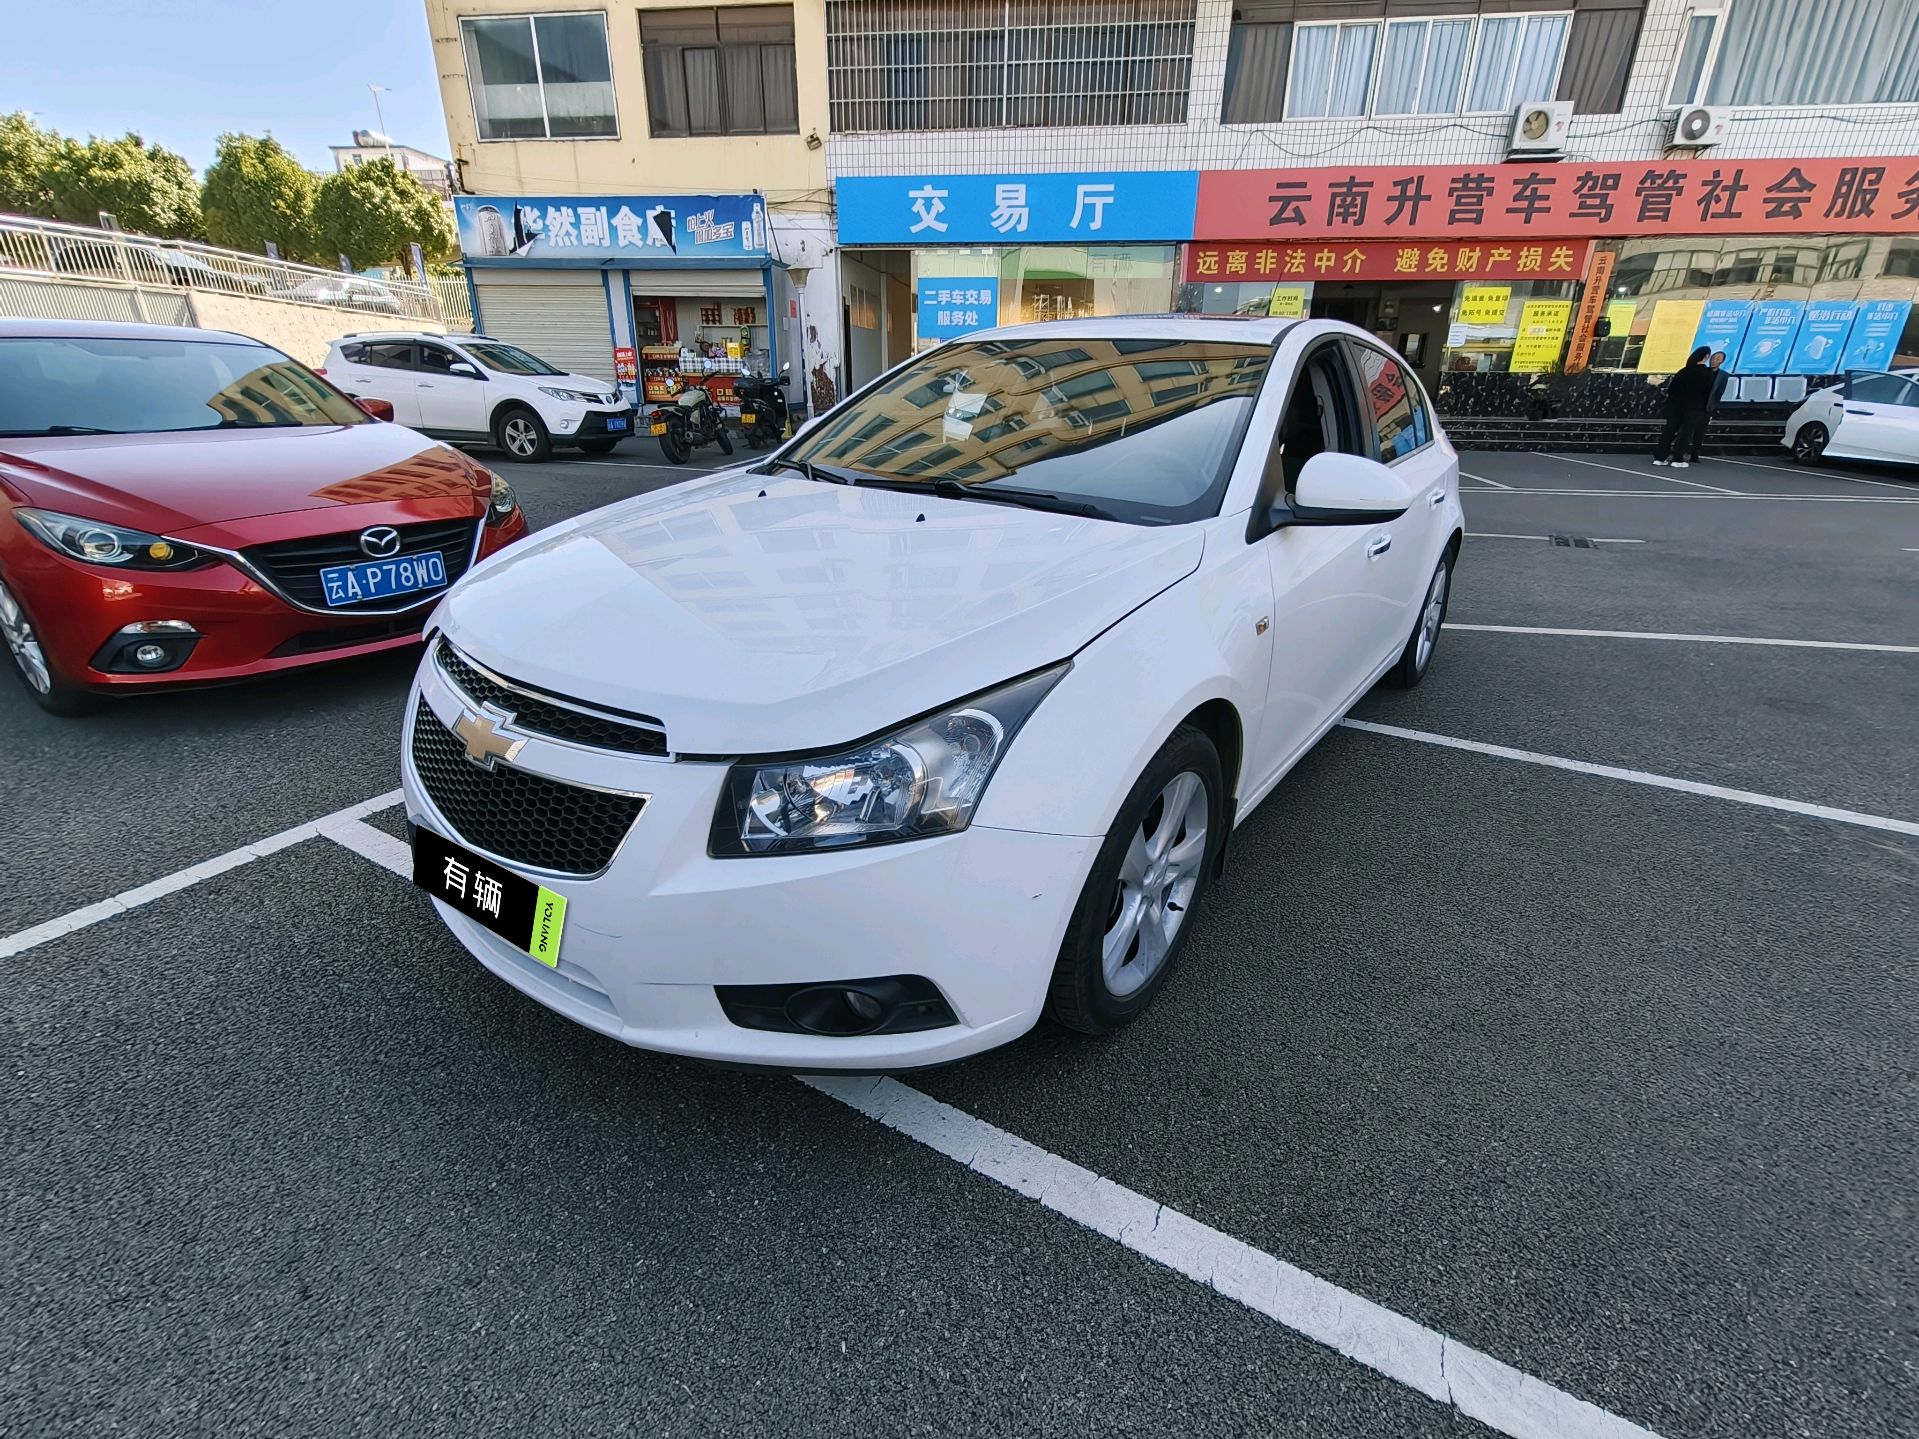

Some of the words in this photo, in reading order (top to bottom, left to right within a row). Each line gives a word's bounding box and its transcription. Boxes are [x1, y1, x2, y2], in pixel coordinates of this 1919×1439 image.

[908, 183, 1115, 233] 交易厅
[1196, 249, 1367, 275] 远离非法中介
[1394, 246, 1574, 274] 避免财产损失
[923, 289, 992, 306] 二手车交易
[936, 310, 978, 326] 服务处
